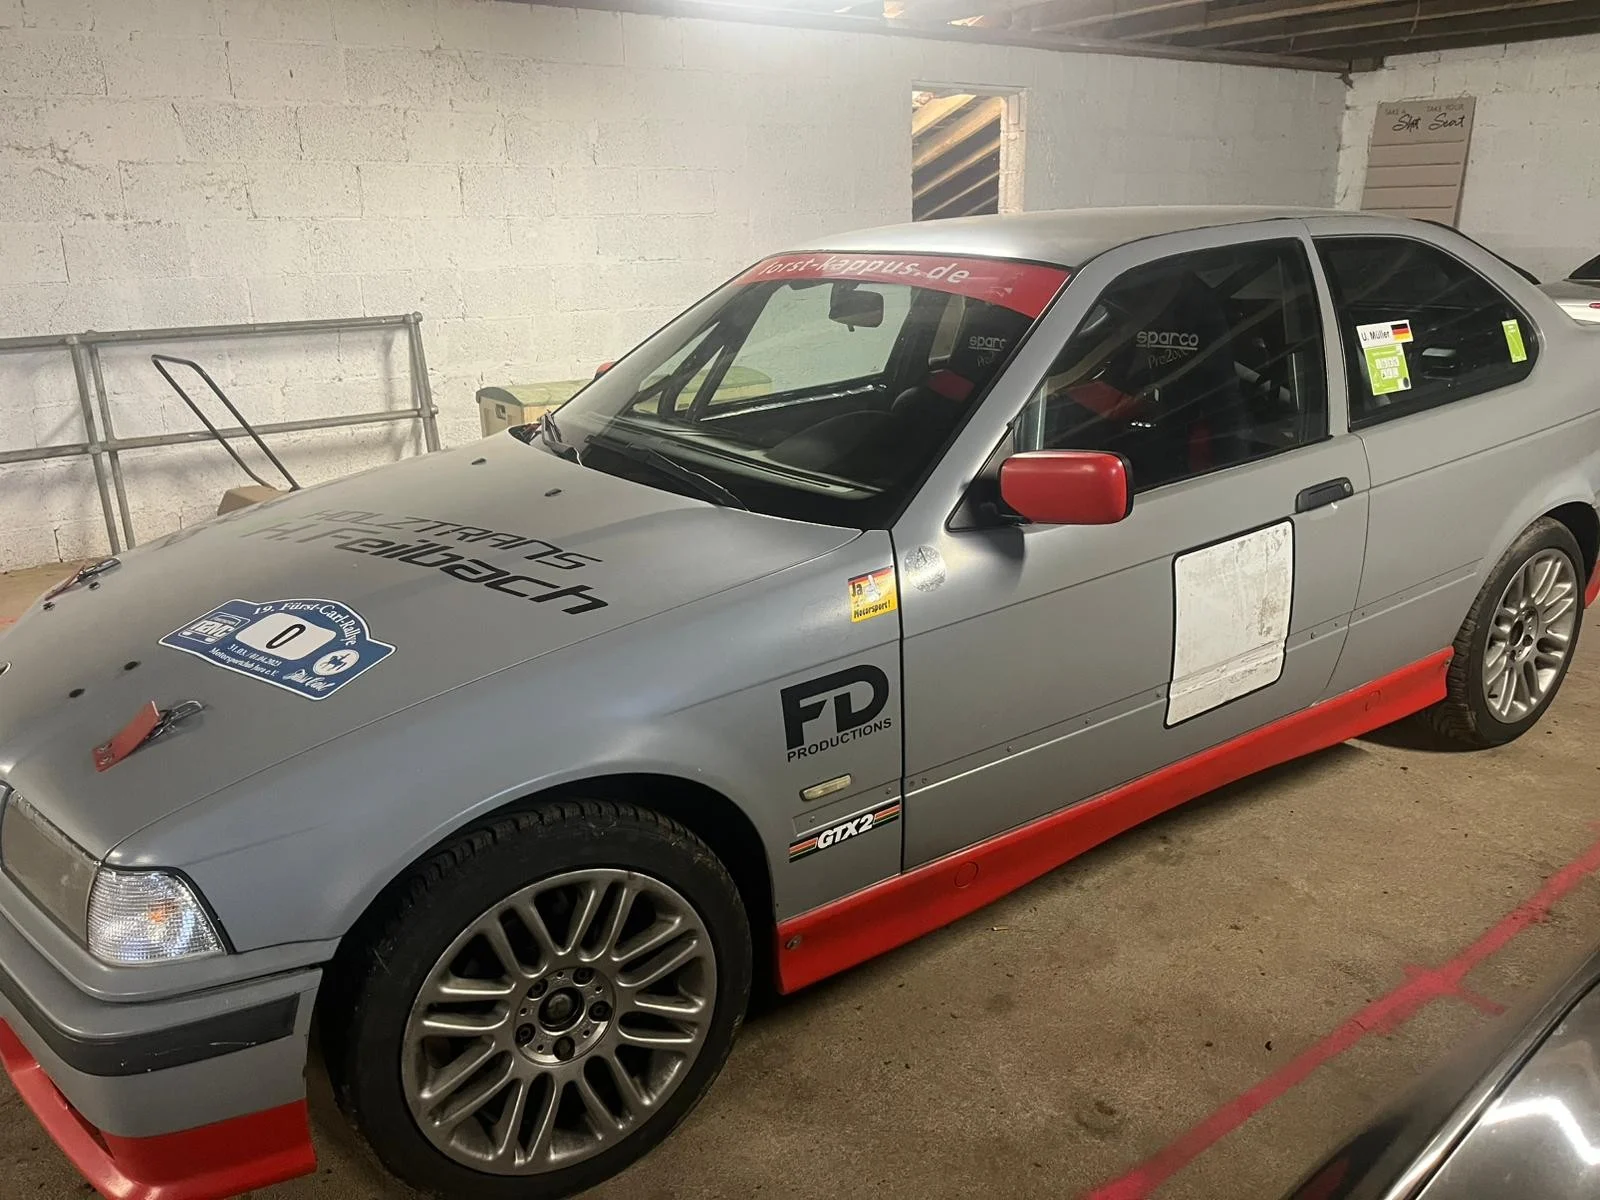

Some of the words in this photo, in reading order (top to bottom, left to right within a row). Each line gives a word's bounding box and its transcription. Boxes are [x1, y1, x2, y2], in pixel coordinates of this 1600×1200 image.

[1136, 331, 1199, 349] sparco
[1371, 330, 1390, 341] Müller
[299, 510, 603, 570] HOLZTRANS
[851, 582, 863, 597] Ja
[253, 604, 275, 615] 19.
[265, 623, 307, 649] 0
[780, 664, 890, 751] FD
[787, 718, 892, 763] PRODUCTIONS
[816, 814, 874, 850] GTX2
